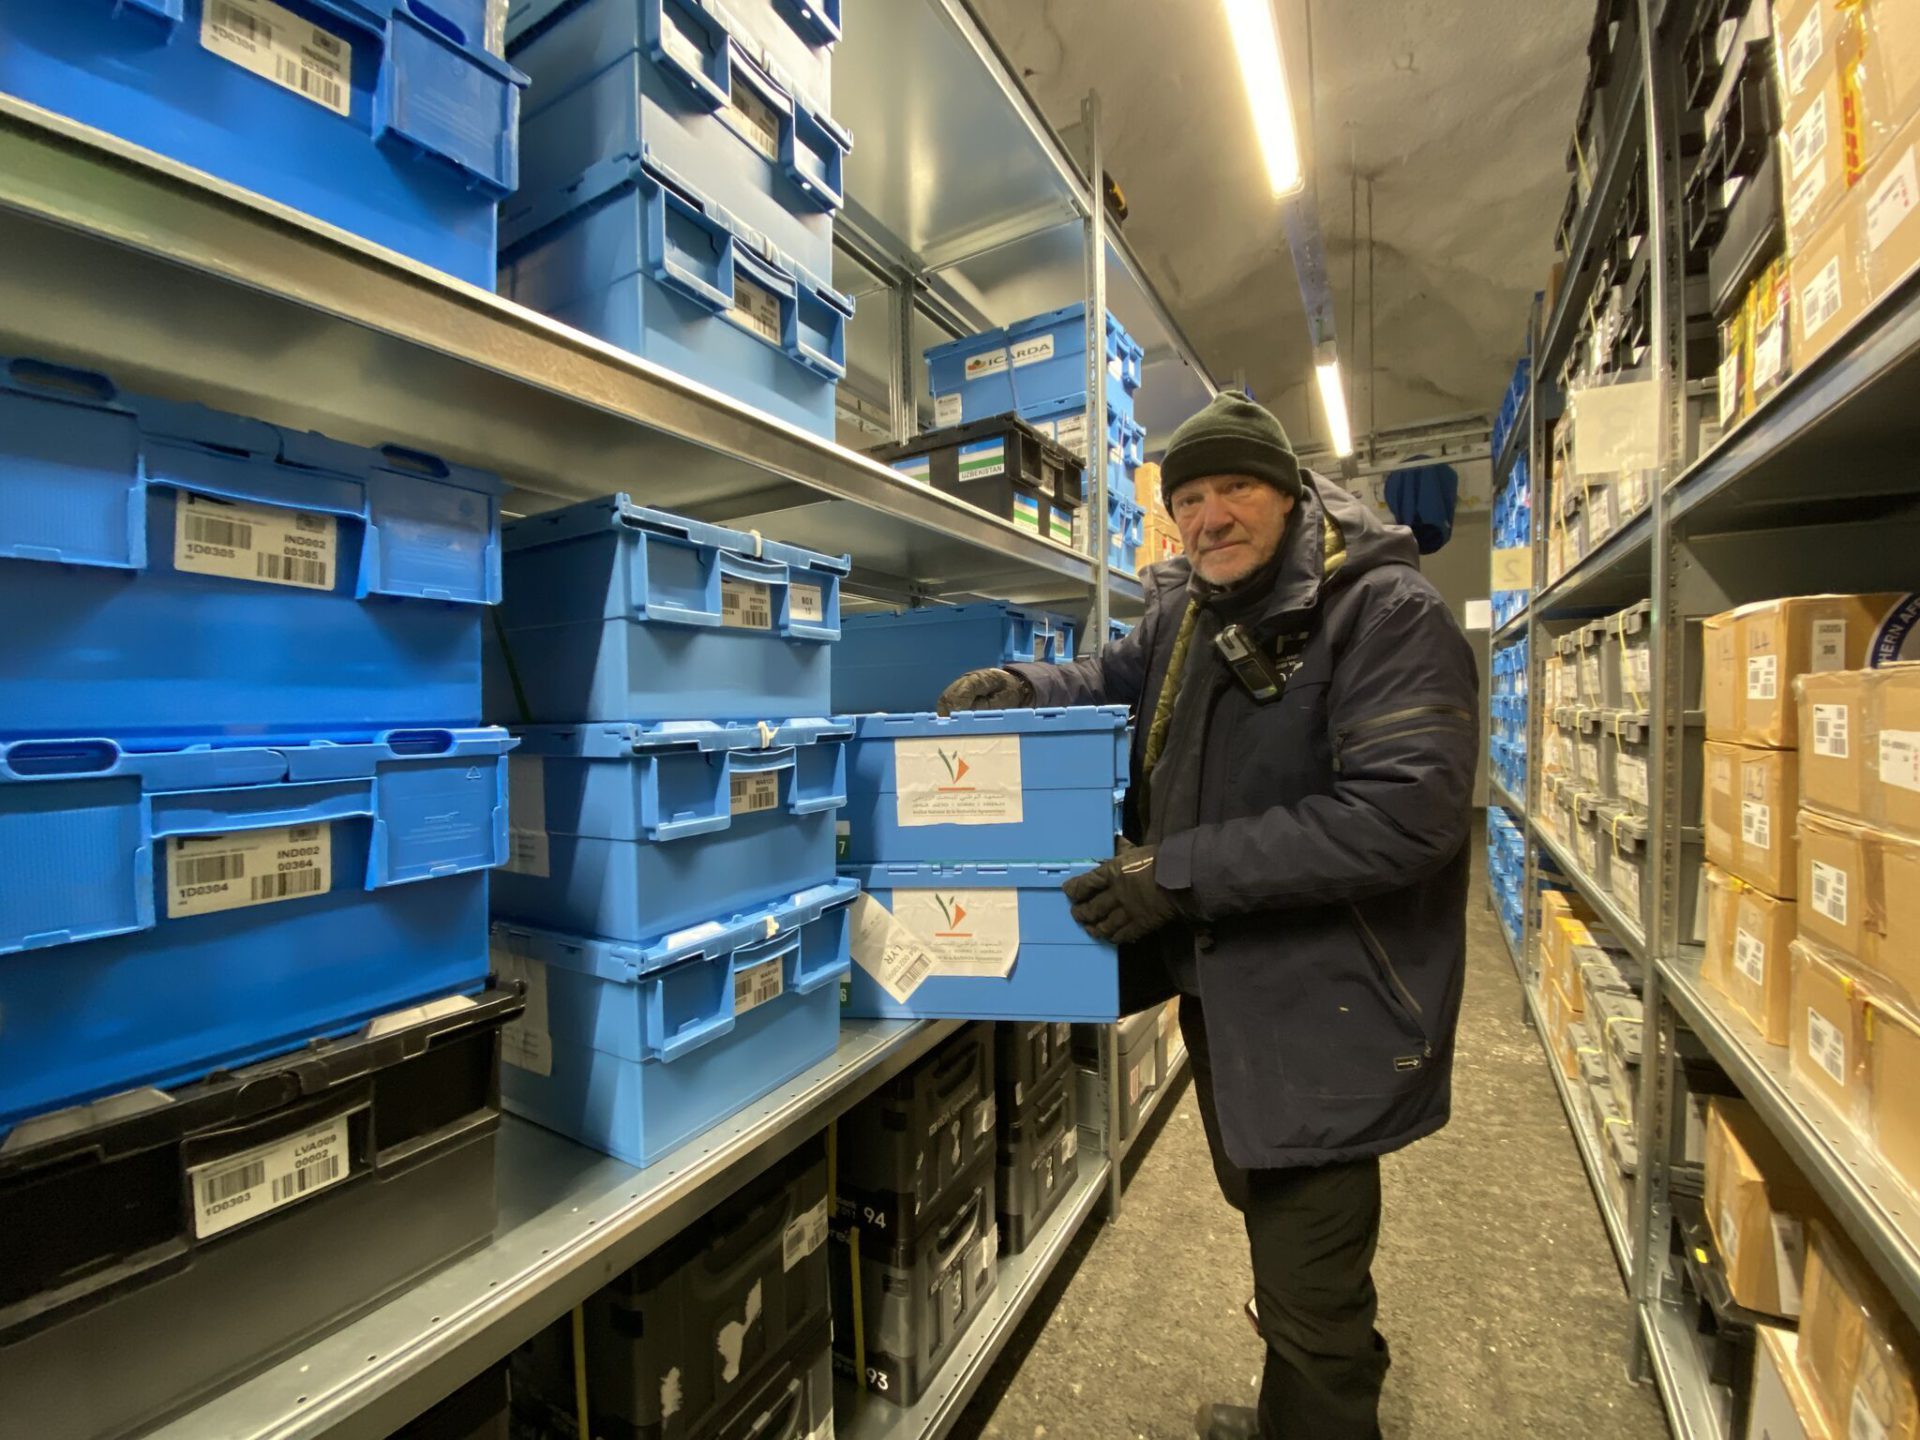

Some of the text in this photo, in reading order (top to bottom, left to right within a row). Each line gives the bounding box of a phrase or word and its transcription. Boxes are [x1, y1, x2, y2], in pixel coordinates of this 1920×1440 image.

[961, 465, 1003, 480] UZBEKISTAN
[277, 846, 321, 860] IND002
[838, 841, 846, 855] 7
[863, 1206, 887, 1229] 94
[866, 1367, 889, 1391] 93
